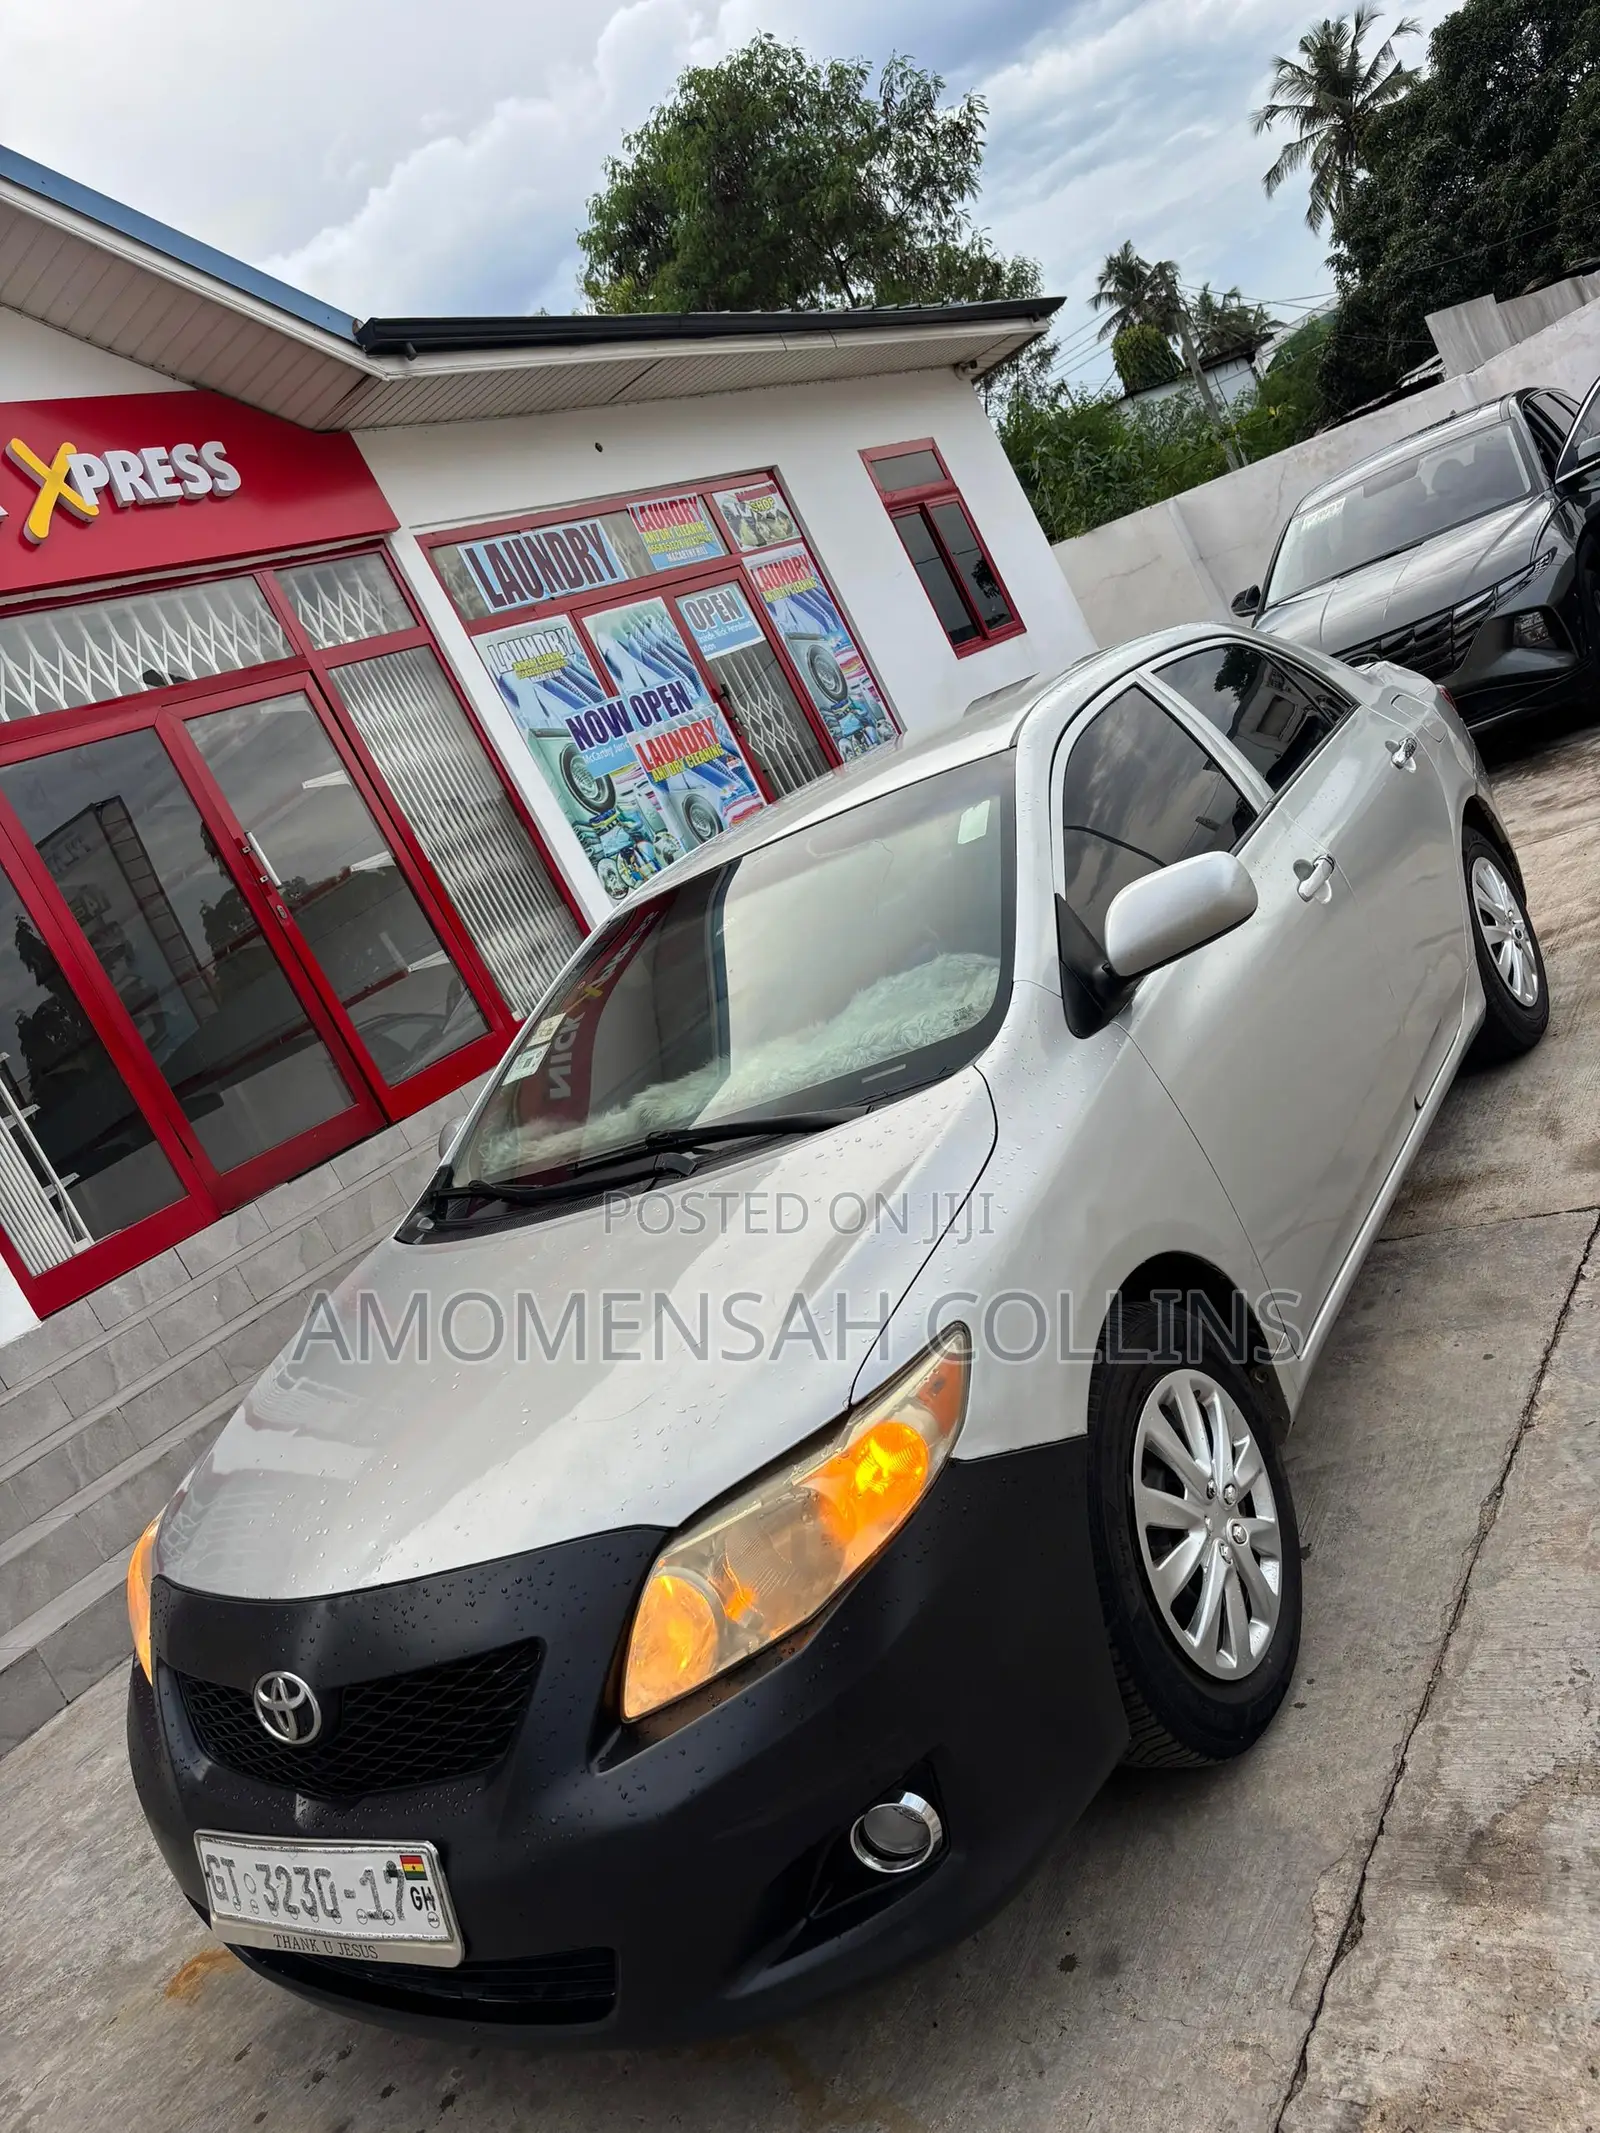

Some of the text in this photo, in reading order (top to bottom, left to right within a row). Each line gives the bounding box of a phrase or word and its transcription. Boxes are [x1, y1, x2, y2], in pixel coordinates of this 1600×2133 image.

[5, 438, 241, 544] XPRESS
[750, 497, 776, 513] SHOP
[629, 496, 704, 533] LAUNDRY
[643, 530, 661, 543] AND
[464, 523, 618, 608] LAUNDRY
[749, 554, 813, 592] LAUNDRY
[684, 588, 745, 631] OPEN
[487, 626, 575, 674] LAUNDRY
[565, 681, 693, 751] NOW OPEN
[635, 717, 719, 771] LAUNDRY
[651, 744, 724, 782] AND DRY CLEANING
[205, 1854, 241, 1909] GT
[410, 1886, 436, 1911] GH
[273, 1934, 378, 1959] THANK U JESUS
